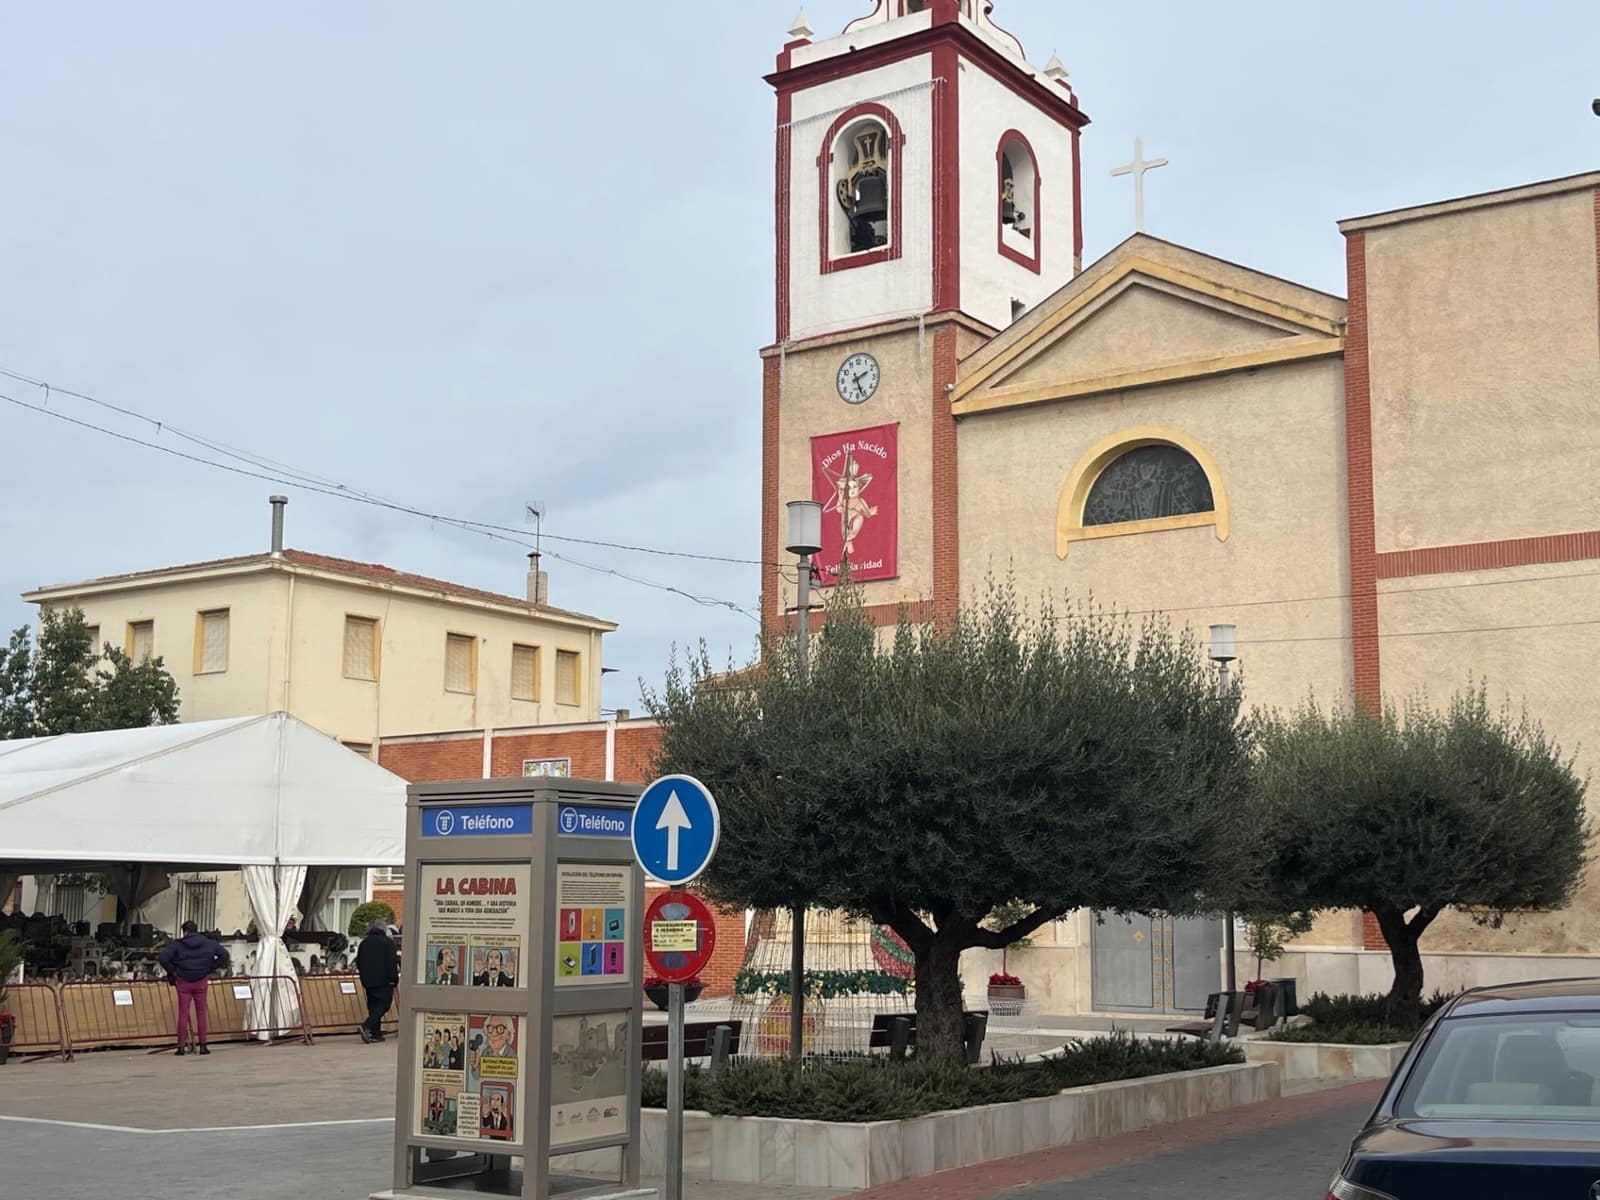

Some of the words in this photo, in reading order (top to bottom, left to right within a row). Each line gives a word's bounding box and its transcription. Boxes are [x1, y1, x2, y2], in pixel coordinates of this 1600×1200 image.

[821, 449, 842, 468] Dios
[842, 442, 856, 454] Ha
[857, 440, 888, 459] Nacido
[825, 563, 842, 575] Feli
[461, 814, 514, 830] Teléfono
[579, 813, 625, 832] Teléfono
[436, 877, 455, 895] LA
[458, 877, 517, 895] CABINA
